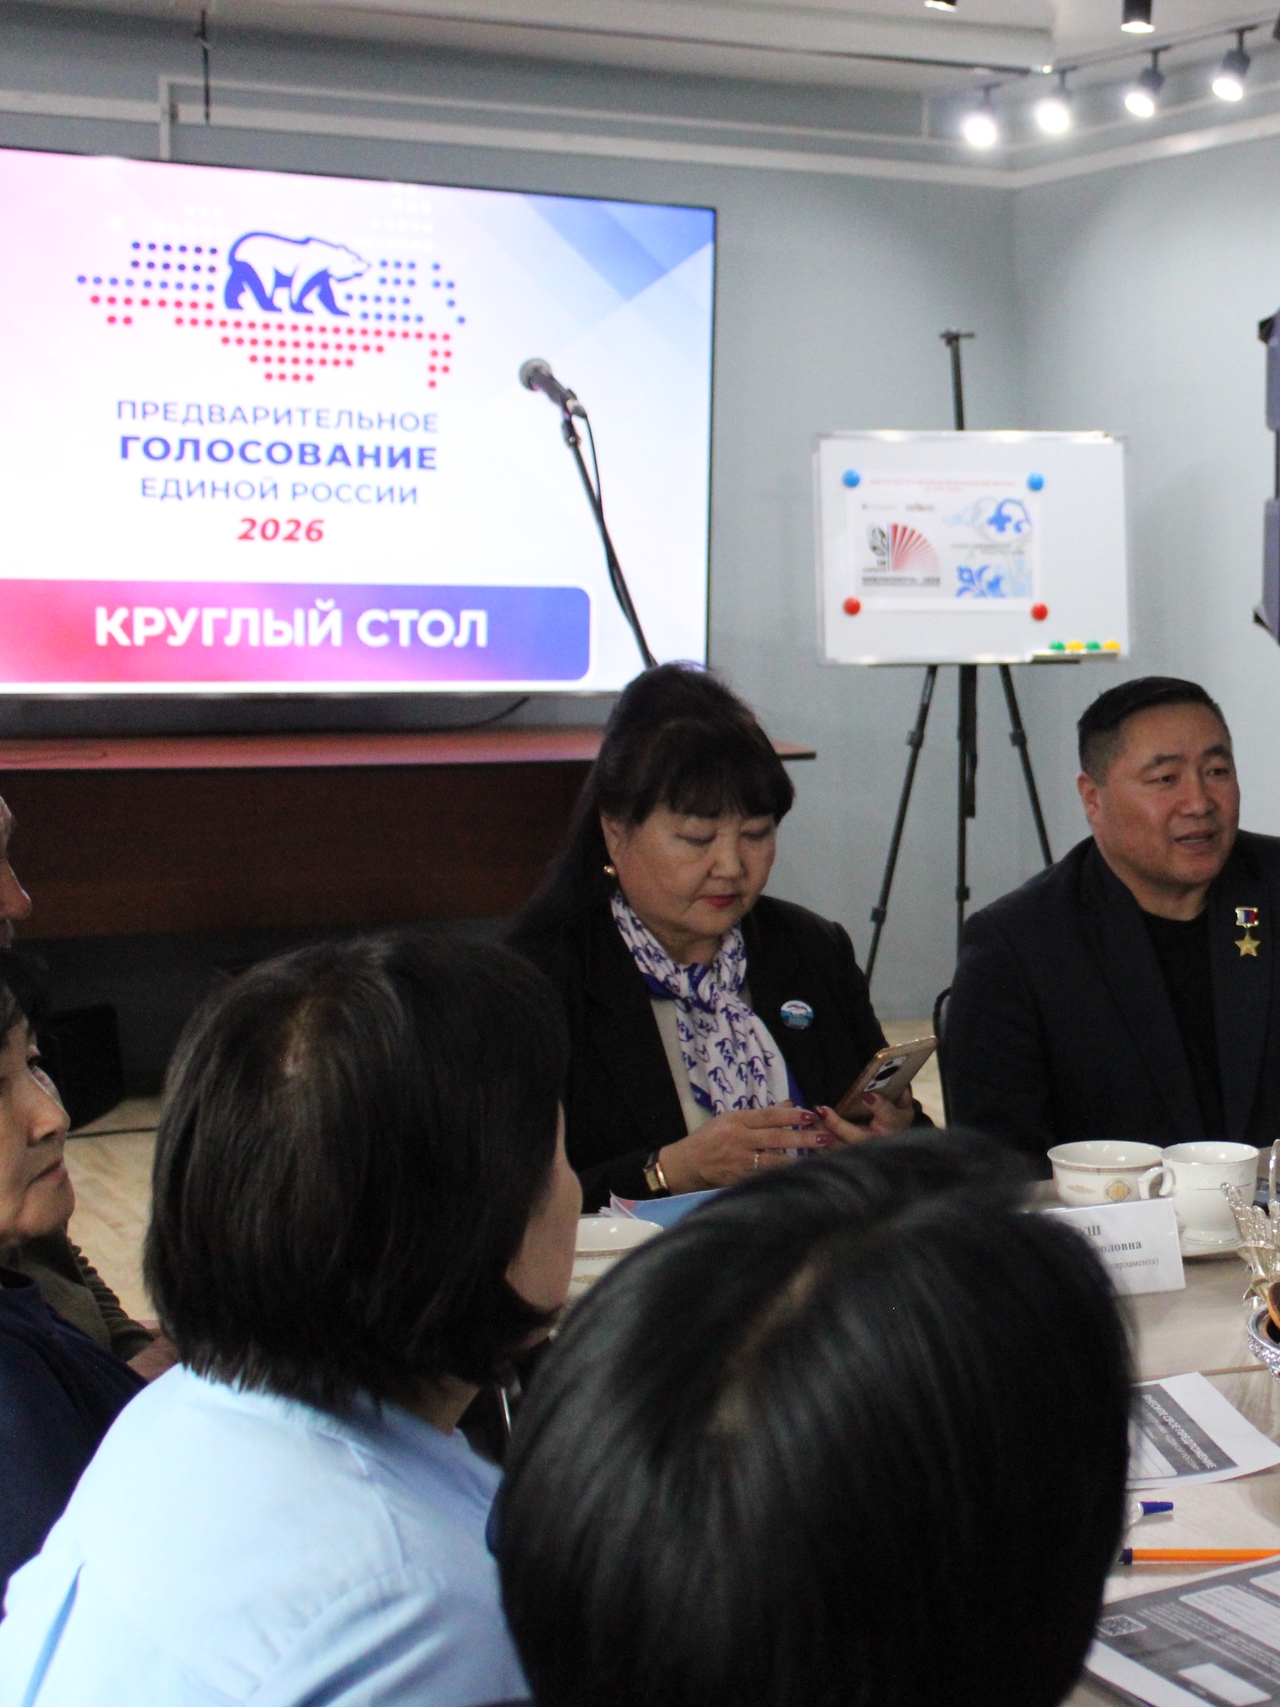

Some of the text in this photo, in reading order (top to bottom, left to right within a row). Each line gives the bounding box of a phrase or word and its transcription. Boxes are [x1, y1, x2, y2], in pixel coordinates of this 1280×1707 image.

[117, 399, 438, 433] ПРЕДВАРИТЕЛЬНОЕ
[120, 435, 437, 471] ГОЛОСОВАНИЕ
[140, 475, 418, 504] ЕДИНОЙ РОССИИ
[237, 517, 325, 542] 2026
[95, 598, 489, 649] КРУГЛЫЙ СТОЛ
